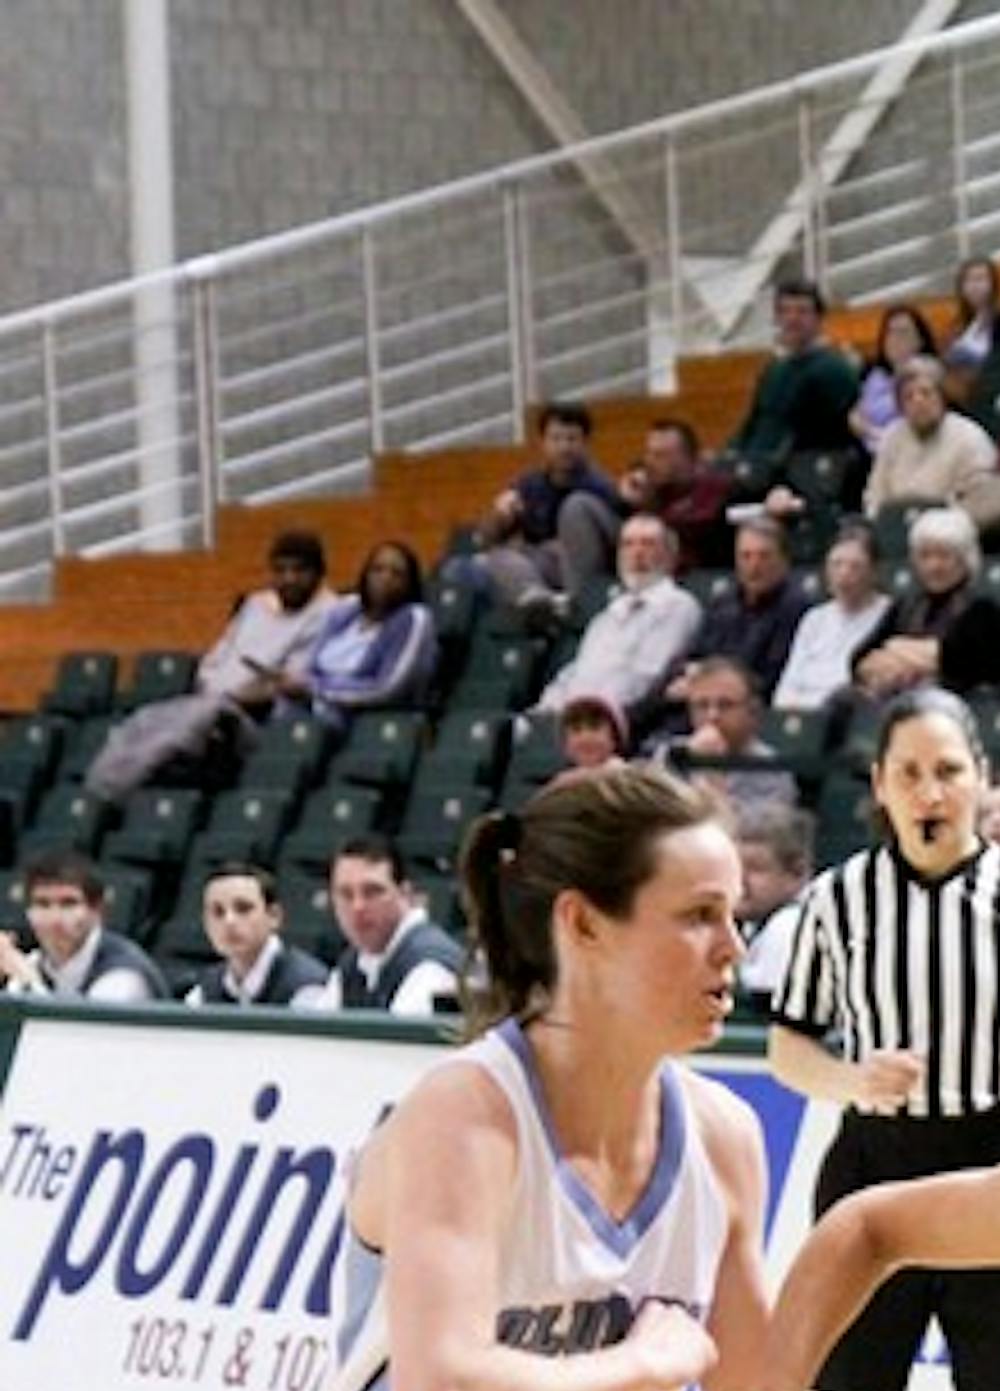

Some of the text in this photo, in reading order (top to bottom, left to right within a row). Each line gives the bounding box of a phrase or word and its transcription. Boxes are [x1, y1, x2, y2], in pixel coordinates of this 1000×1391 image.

[1, 1123, 76, 1201] The
[123, 1318, 216, 1383] 103.1
[222, 1327, 255, 1387] &
